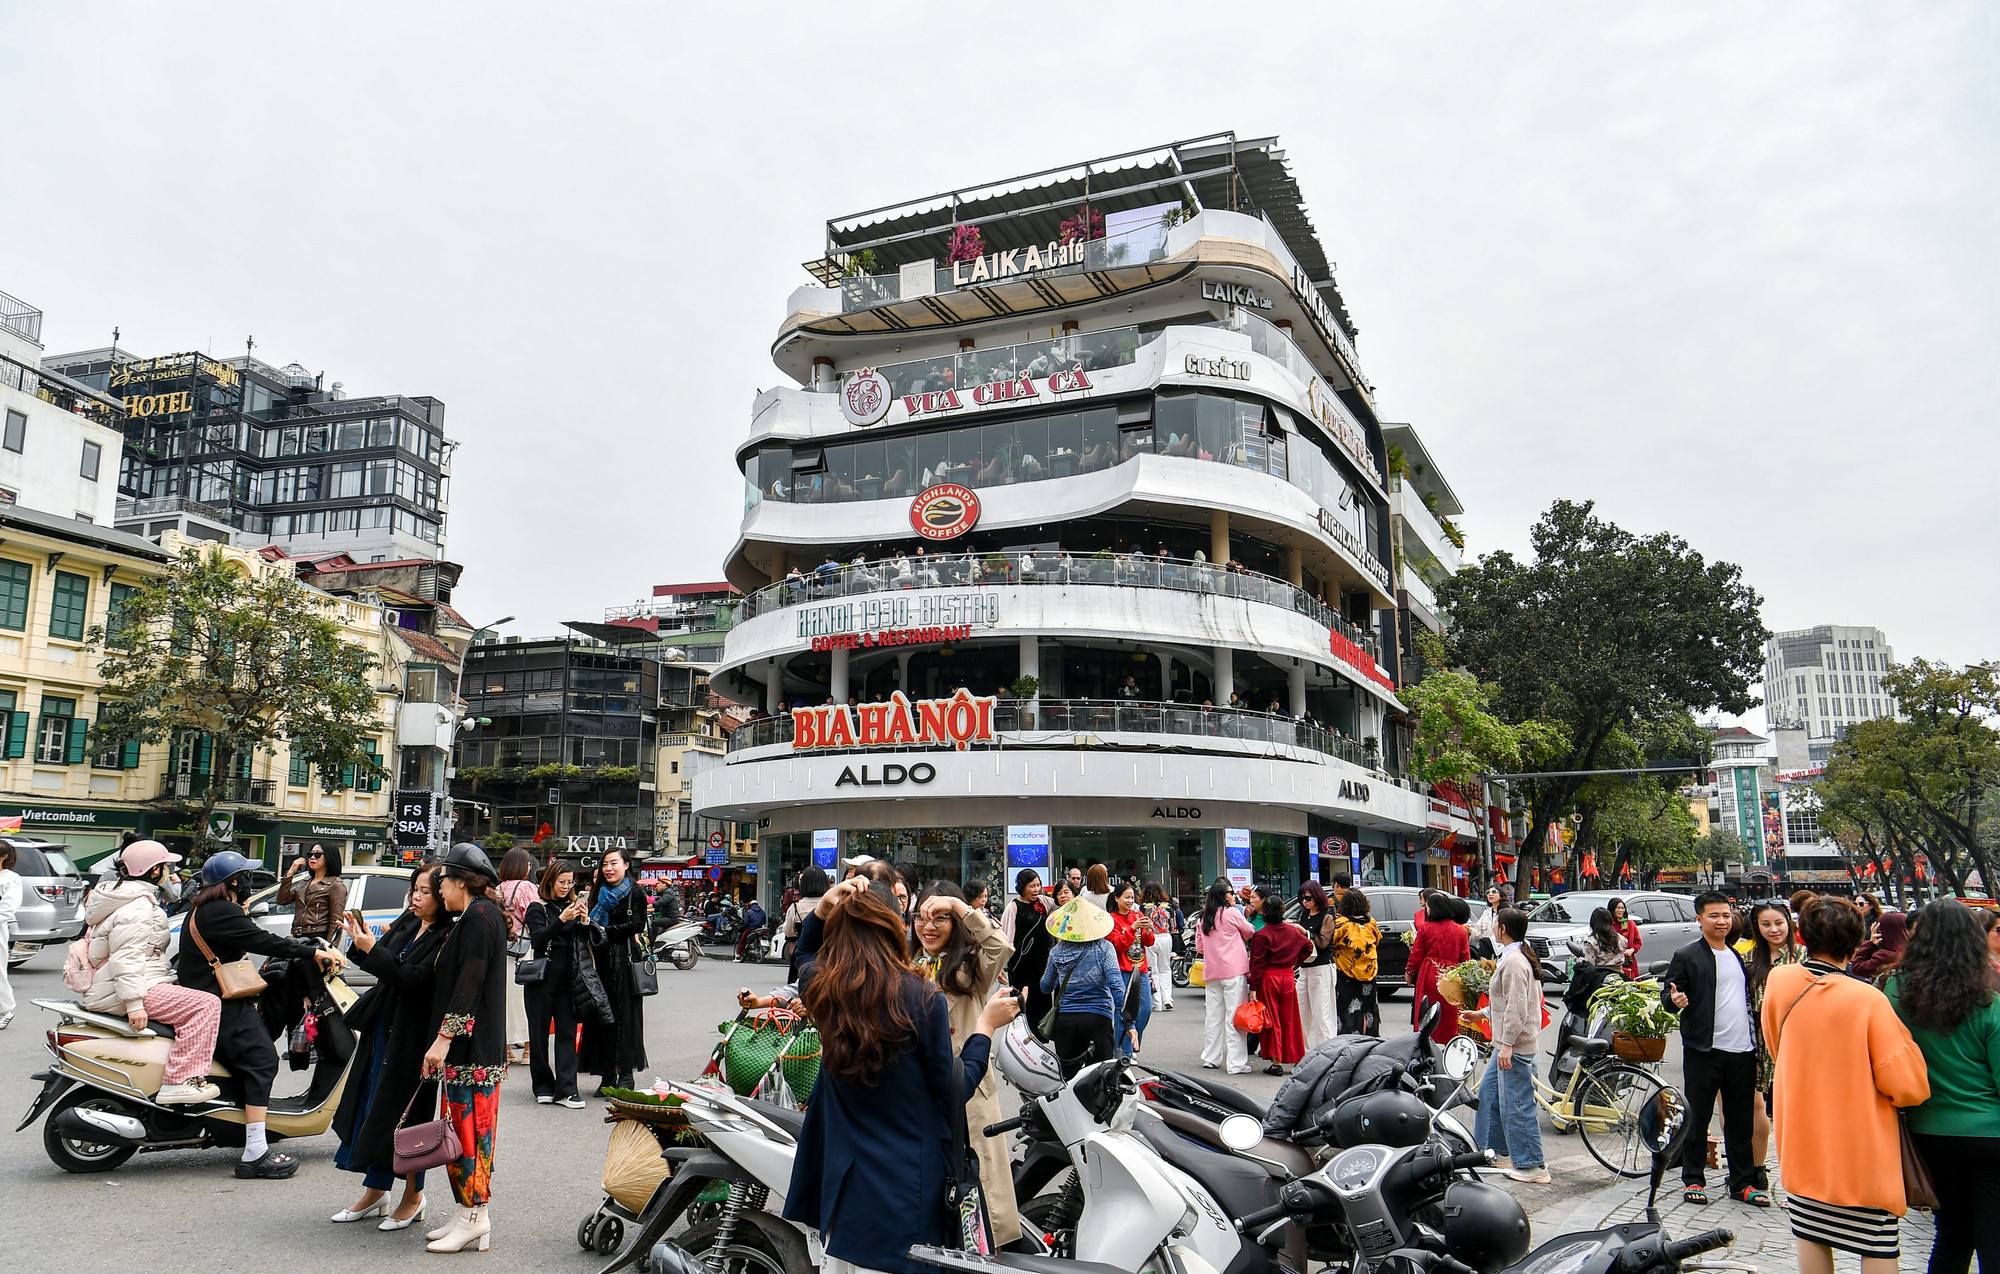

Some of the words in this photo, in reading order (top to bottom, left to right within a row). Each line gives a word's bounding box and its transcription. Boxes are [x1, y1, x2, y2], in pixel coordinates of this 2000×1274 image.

[953, 243, 1044, 286] LAIKA
[1047, 236, 1085, 268] Café
[1201, 280, 1258, 307] LAIKA
[151, 367, 192, 381] LOUNGE
[1233, 360, 1252, 381] 10
[901, 387, 963, 416] VUA
[972, 368, 1039, 405] CHẢ
[1048, 362, 1094, 393] CÁ
[122, 391, 192, 418] HOTEL
[913, 487, 975, 513] HIGHLANDS
[921, 520, 968, 537] COFFEE
[1320, 508, 1367, 564] HIGHLANDS
[1366, 551, 1389, 587] COFFEE
[796, 602, 853, 638] HANOI
[859, 596, 910, 630] 1930
[918, 592, 999, 626] BISTRO
[811, 633, 860, 652] COFFEE
[863, 632, 874, 648] &
[878, 624, 973, 647] RESTAURANT
[792, 704, 856, 750] BIA
[857, 693, 916, 746] HÀ
[917, 689, 996, 752] NỘI
[834, 762, 936, 787] ALDO
[1337, 778, 1370, 802] ALDO
[22, 809, 96, 823] Vietcombank
[403, 804, 422, 817] FS
[1151, 806, 1202, 819] ALDO
[312, 825, 358, 837] Vietcombank
[398, 821, 426, 833] SPA
[357, 842, 374, 850] ATM
